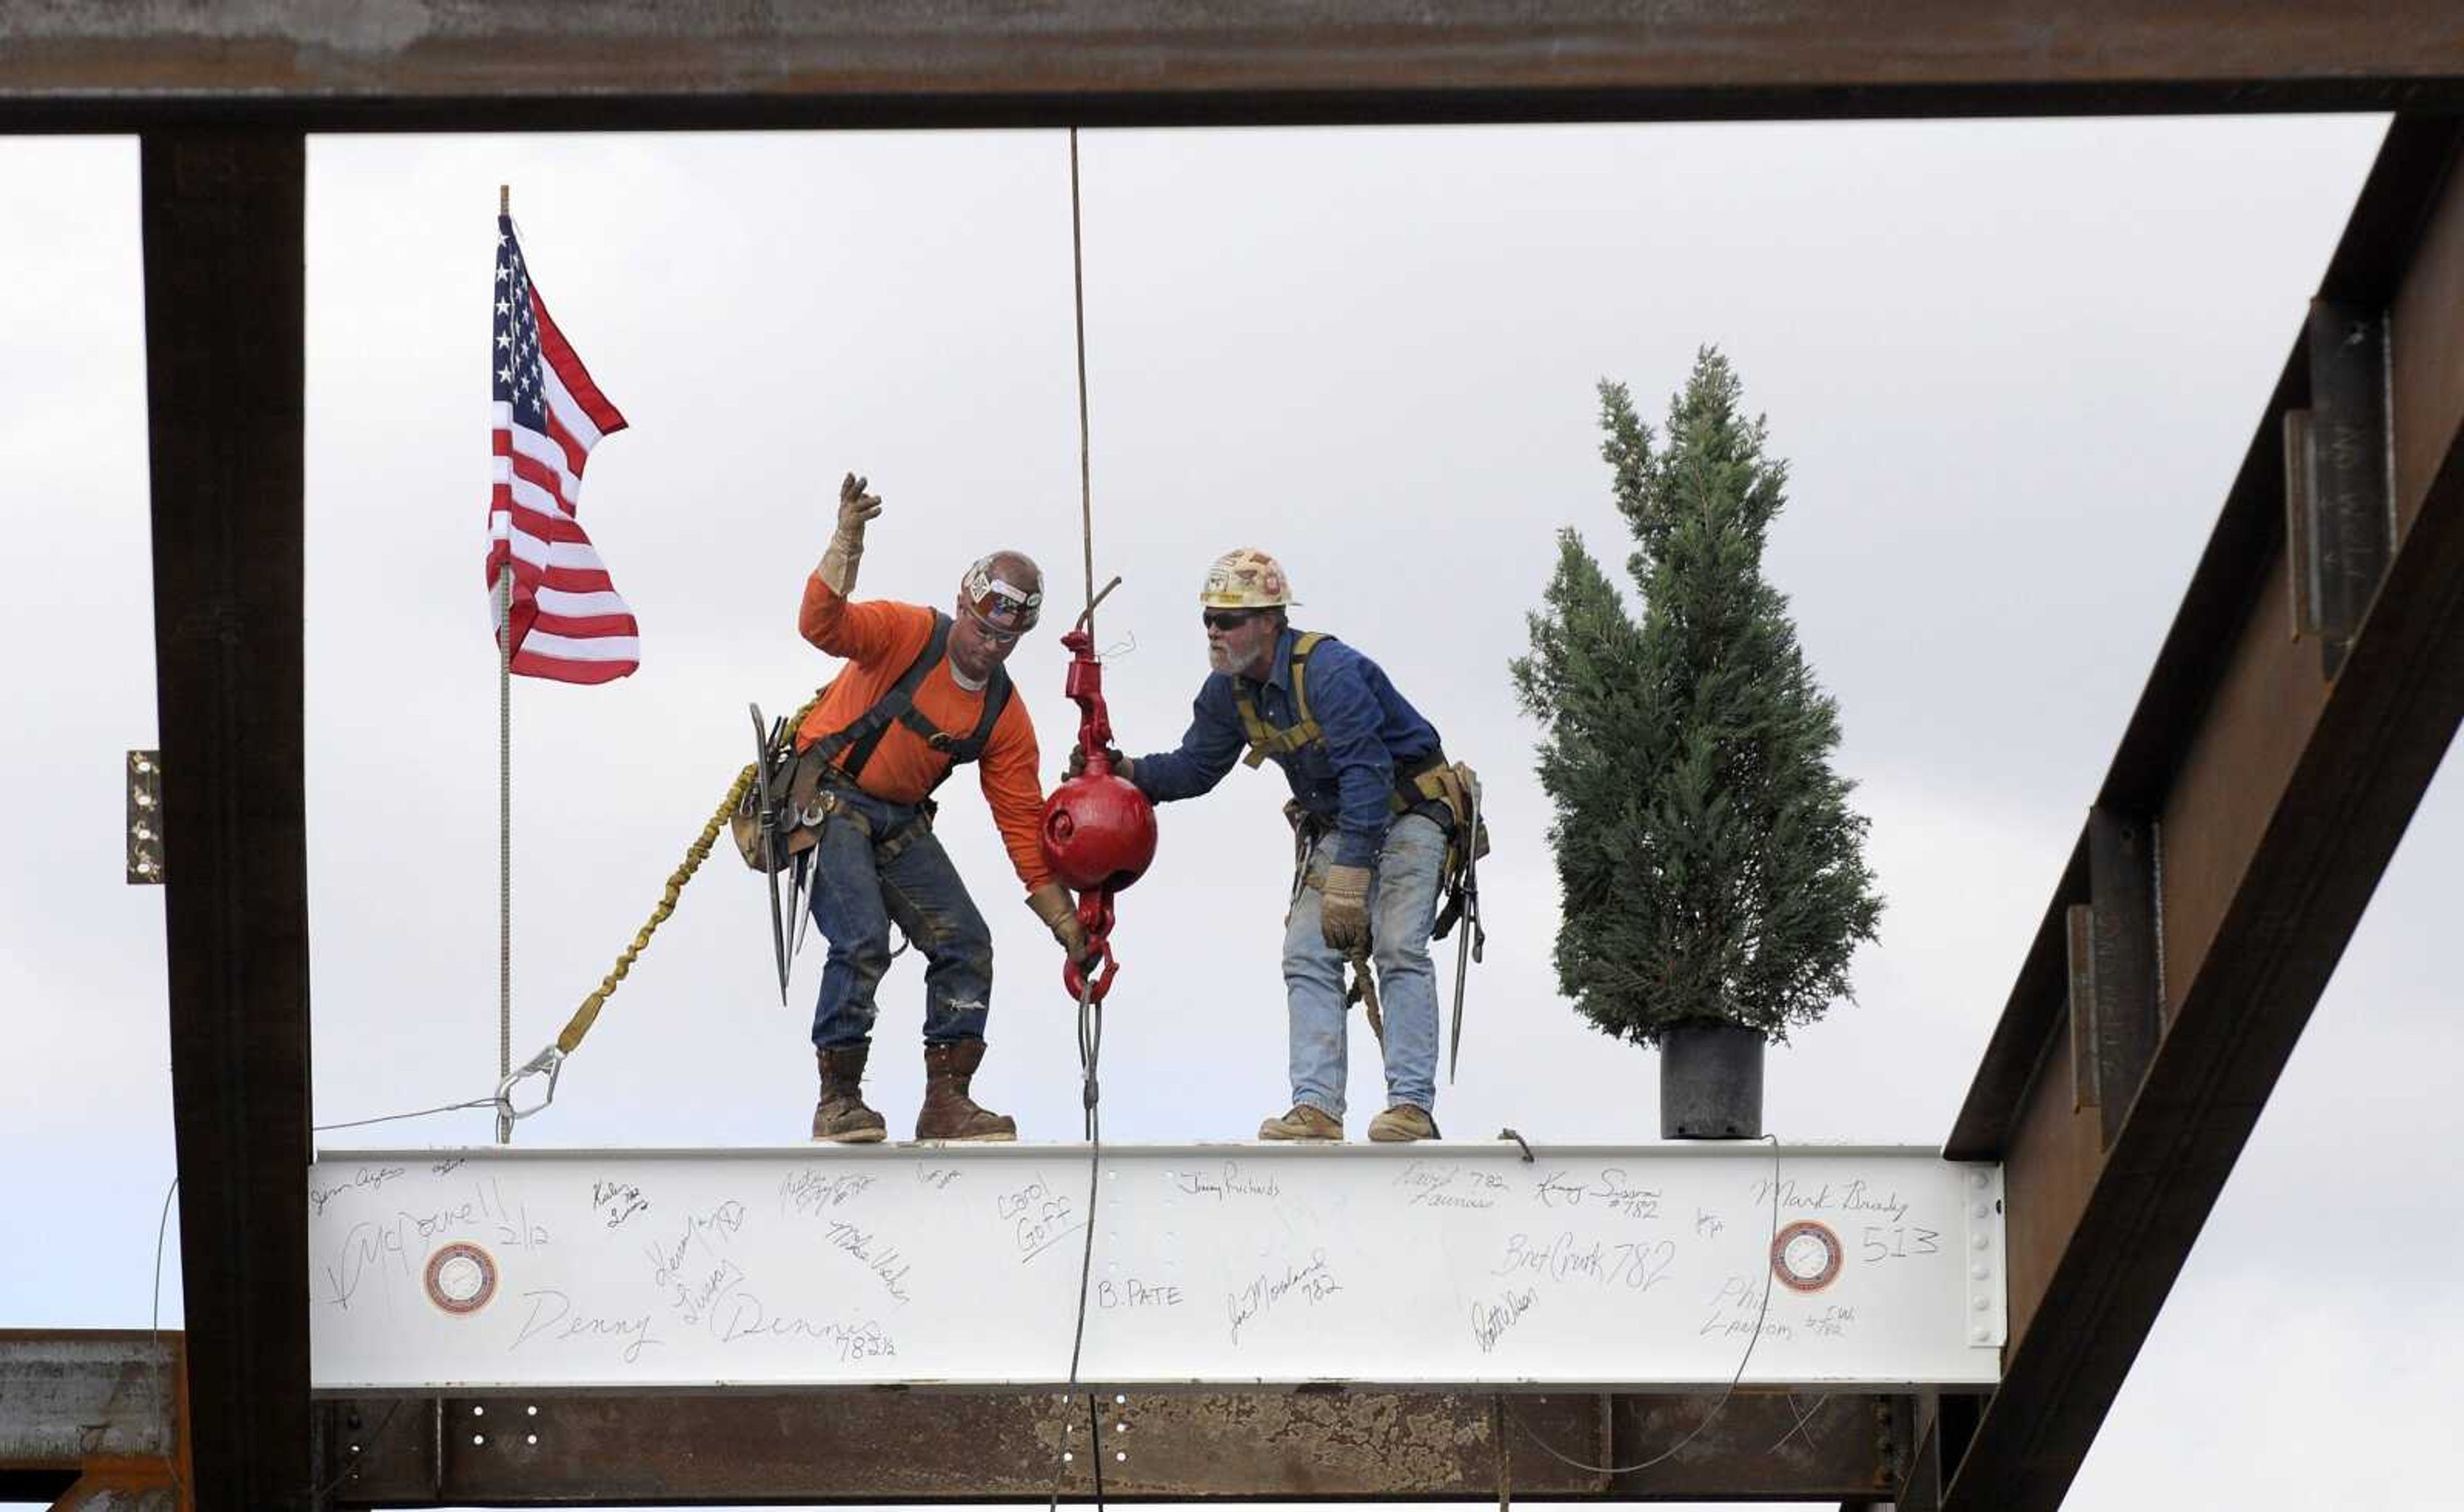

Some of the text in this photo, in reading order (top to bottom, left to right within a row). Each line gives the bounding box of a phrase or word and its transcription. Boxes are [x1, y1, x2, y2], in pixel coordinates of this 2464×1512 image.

[1861, 1226, 1940, 1262] 513
[1605, 1239, 1676, 1292] 782
[1127, 1278, 1184, 1306] PATE
[1301, 1274, 1344, 1307] 782
[509, 1290, 665, 1364] Denny
[710, 1288, 882, 1343] Dennis
